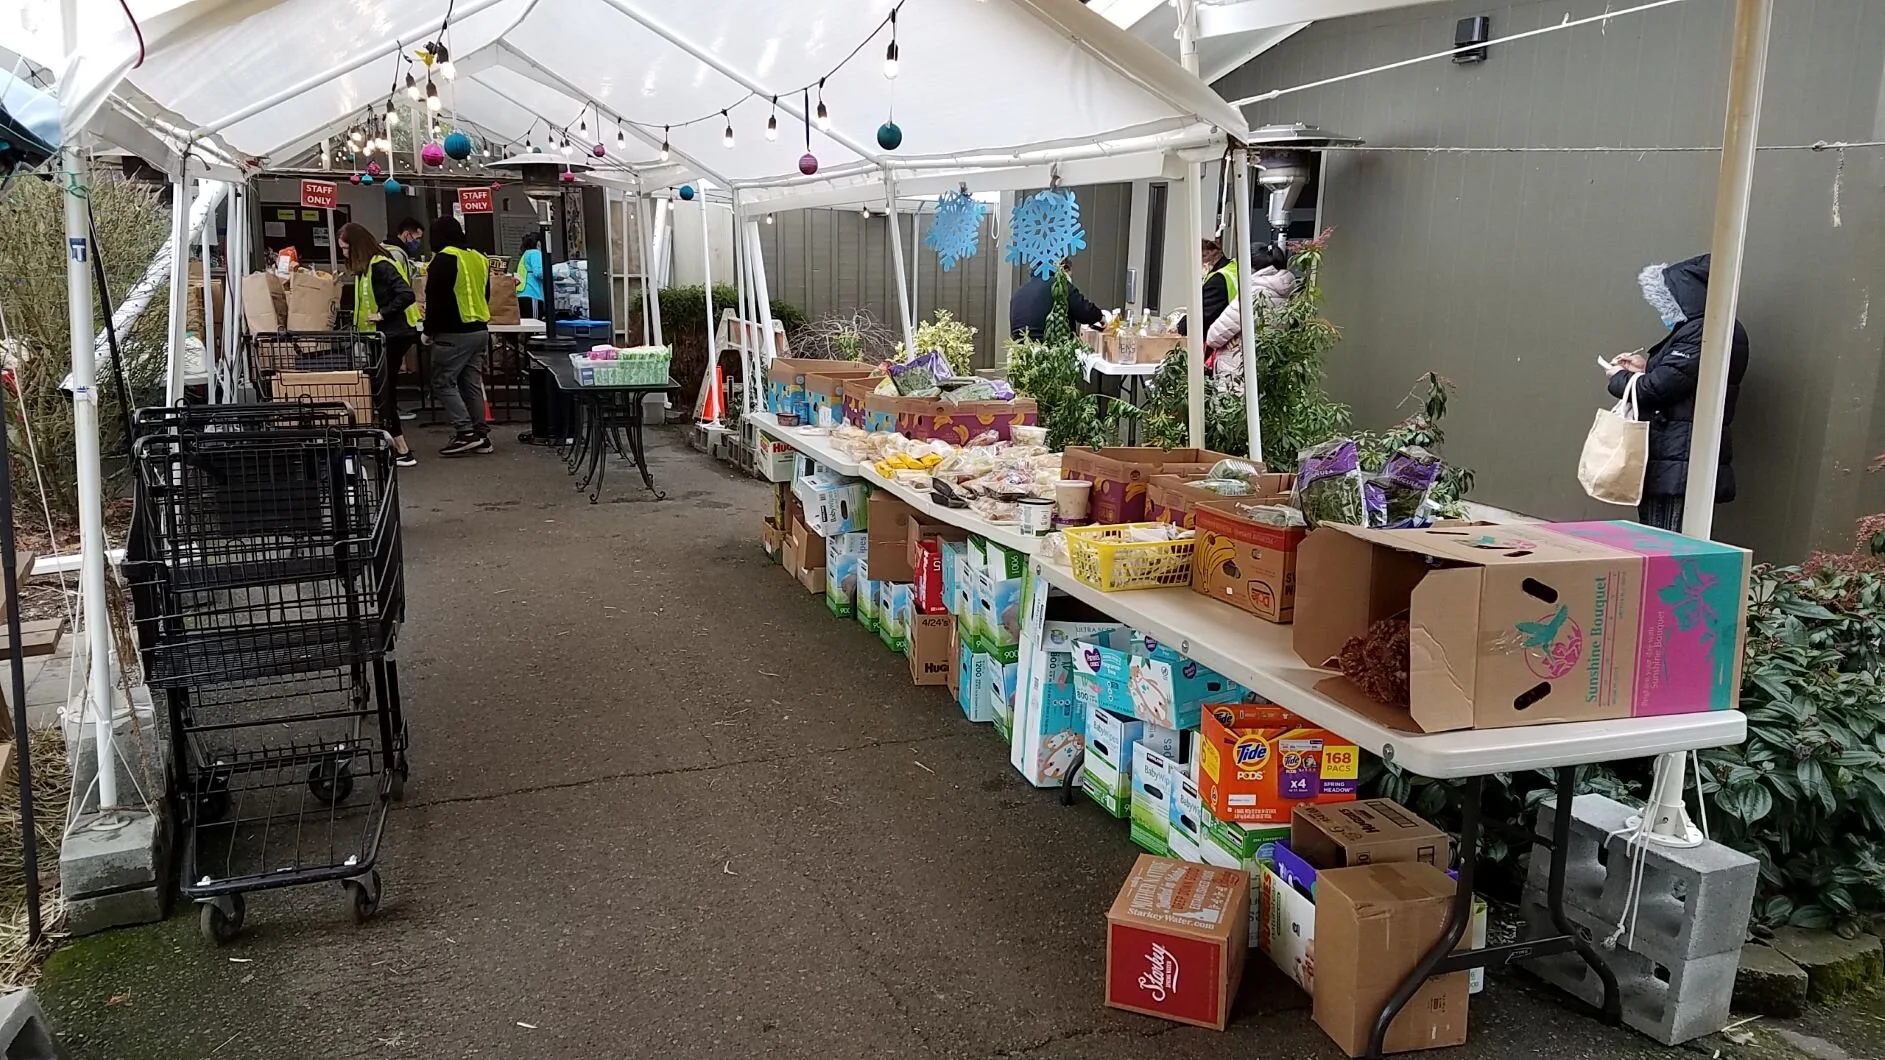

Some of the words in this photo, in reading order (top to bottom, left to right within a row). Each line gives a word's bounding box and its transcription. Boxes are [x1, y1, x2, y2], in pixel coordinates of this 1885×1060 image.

[306, 184, 333, 194] STAFF
[462, 191, 488, 200] STAFF
[307, 195, 332, 205] ONLY
[464, 202, 488, 210] ONLY
[860, 536, 868, 554] ipes
[1590, 577, 1607, 636] Bouquet
[1654, 611, 1665, 648] Bouquet
[1586, 641, 1601, 703] Sunshine
[1651, 649, 1661, 689] Sunshine
[1237, 742, 1267, 765] Tide
[1284, 755, 1300, 766] Tide
[1326, 752, 1352, 764] 168
[1237, 771, 1264, 781] PODS
[1290, 778, 1306, 789] x4
[1127, 908, 1215, 930] StarkeyWater.com
[1138, 942, 1167, 1002] Starkey
